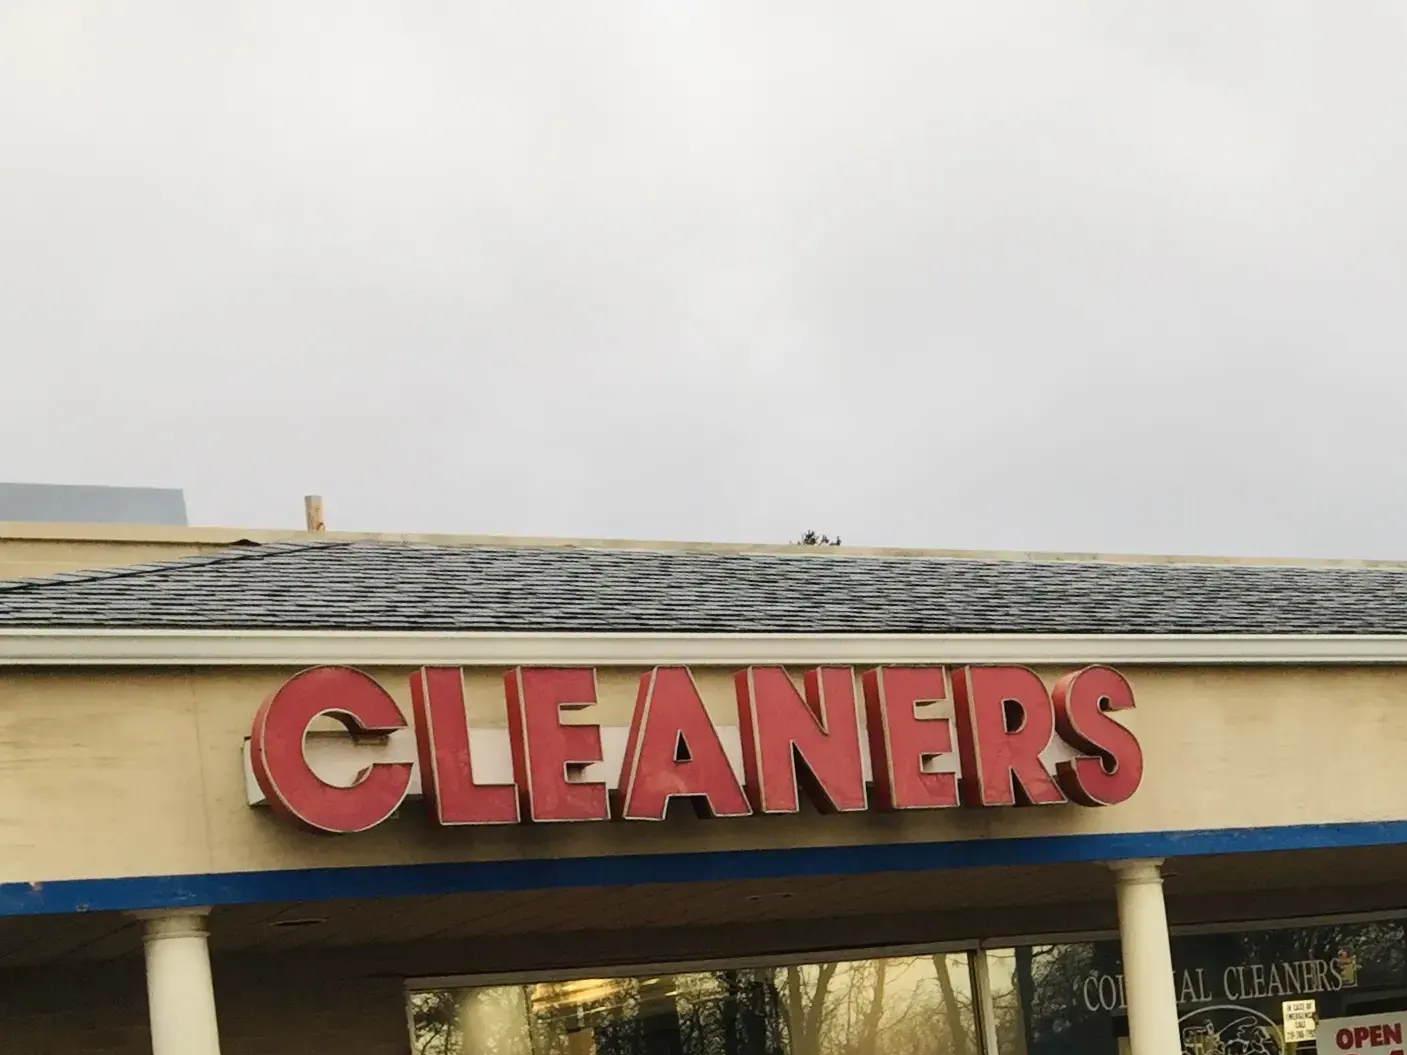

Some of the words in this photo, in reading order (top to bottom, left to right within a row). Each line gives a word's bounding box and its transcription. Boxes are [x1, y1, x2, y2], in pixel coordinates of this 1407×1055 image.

[251, 664, 1144, 834] CLEANERS
[1084, 968, 1212, 1011] COLAL
[1223, 958, 1343, 1001] CLEANERS
[1336, 1023, 1402, 1050] OPEN
